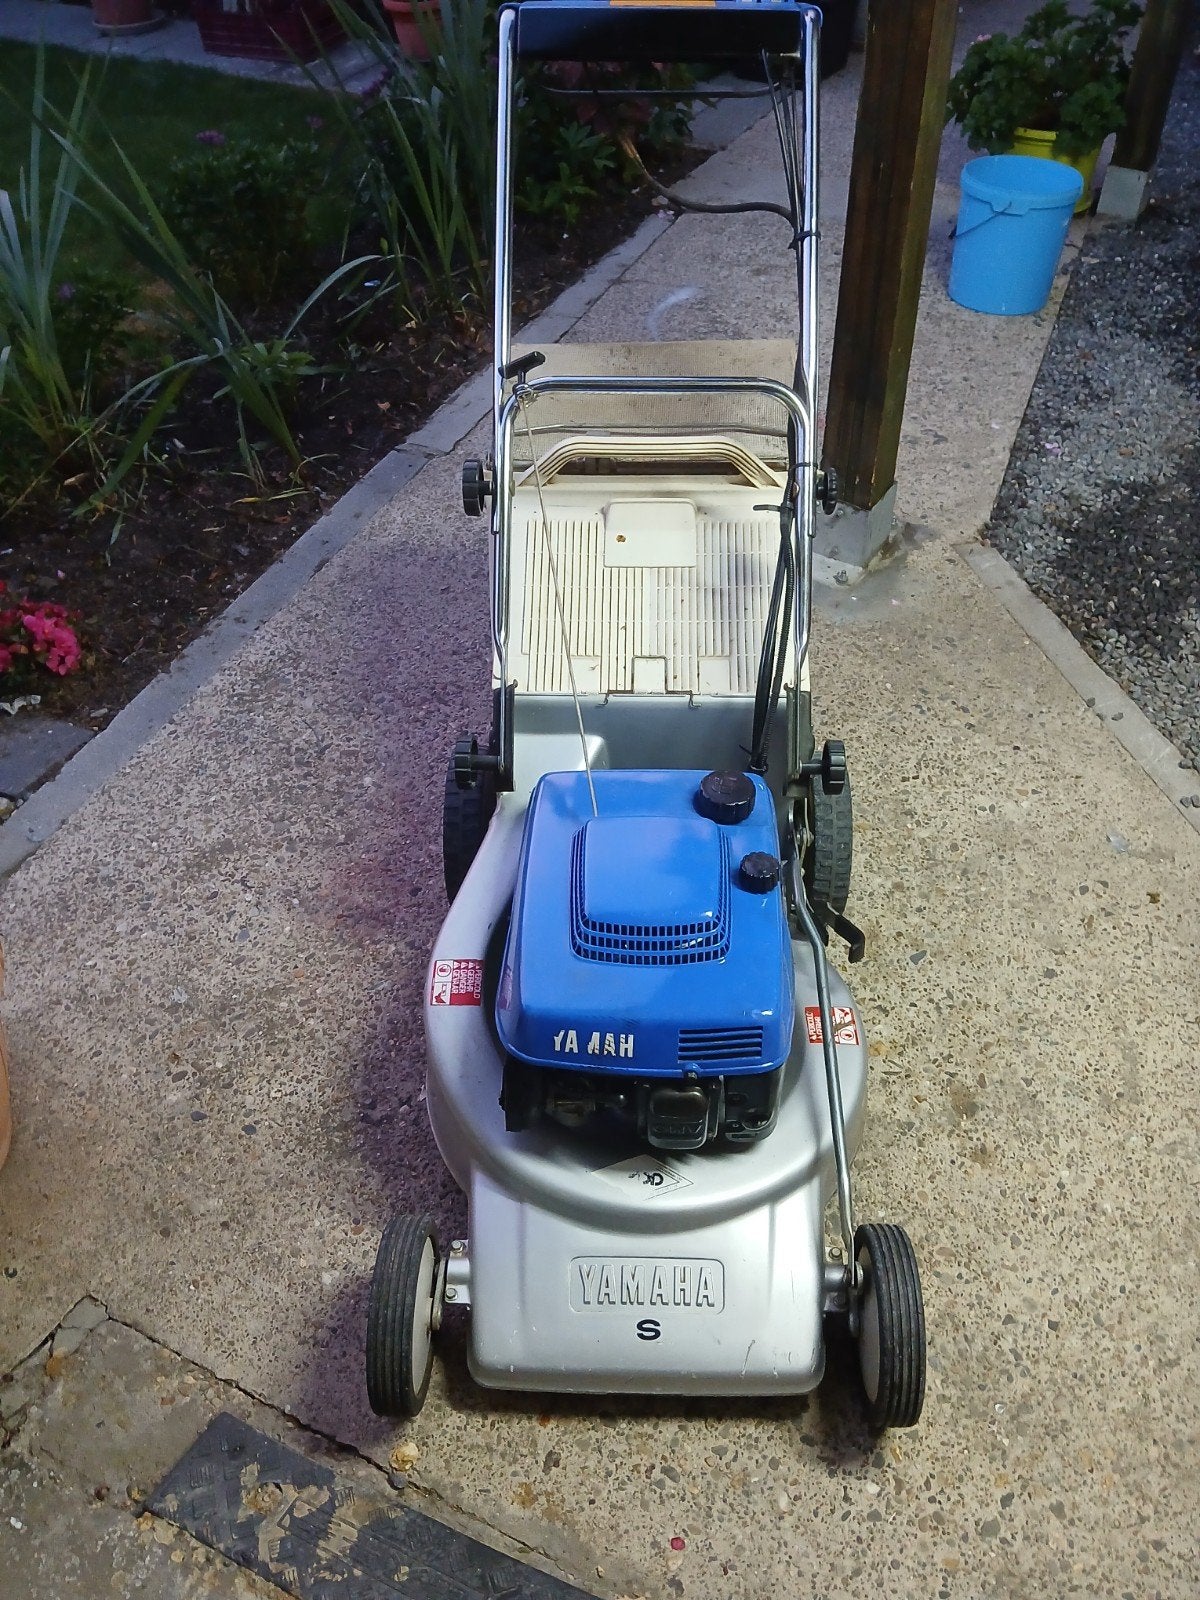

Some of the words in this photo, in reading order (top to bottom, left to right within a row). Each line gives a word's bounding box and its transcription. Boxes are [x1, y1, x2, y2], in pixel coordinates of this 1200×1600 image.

[459, 969, 467, 994] DANGER
[578, 1264, 715, 1307] YAMAHA
[636, 1319, 661, 1341] S
